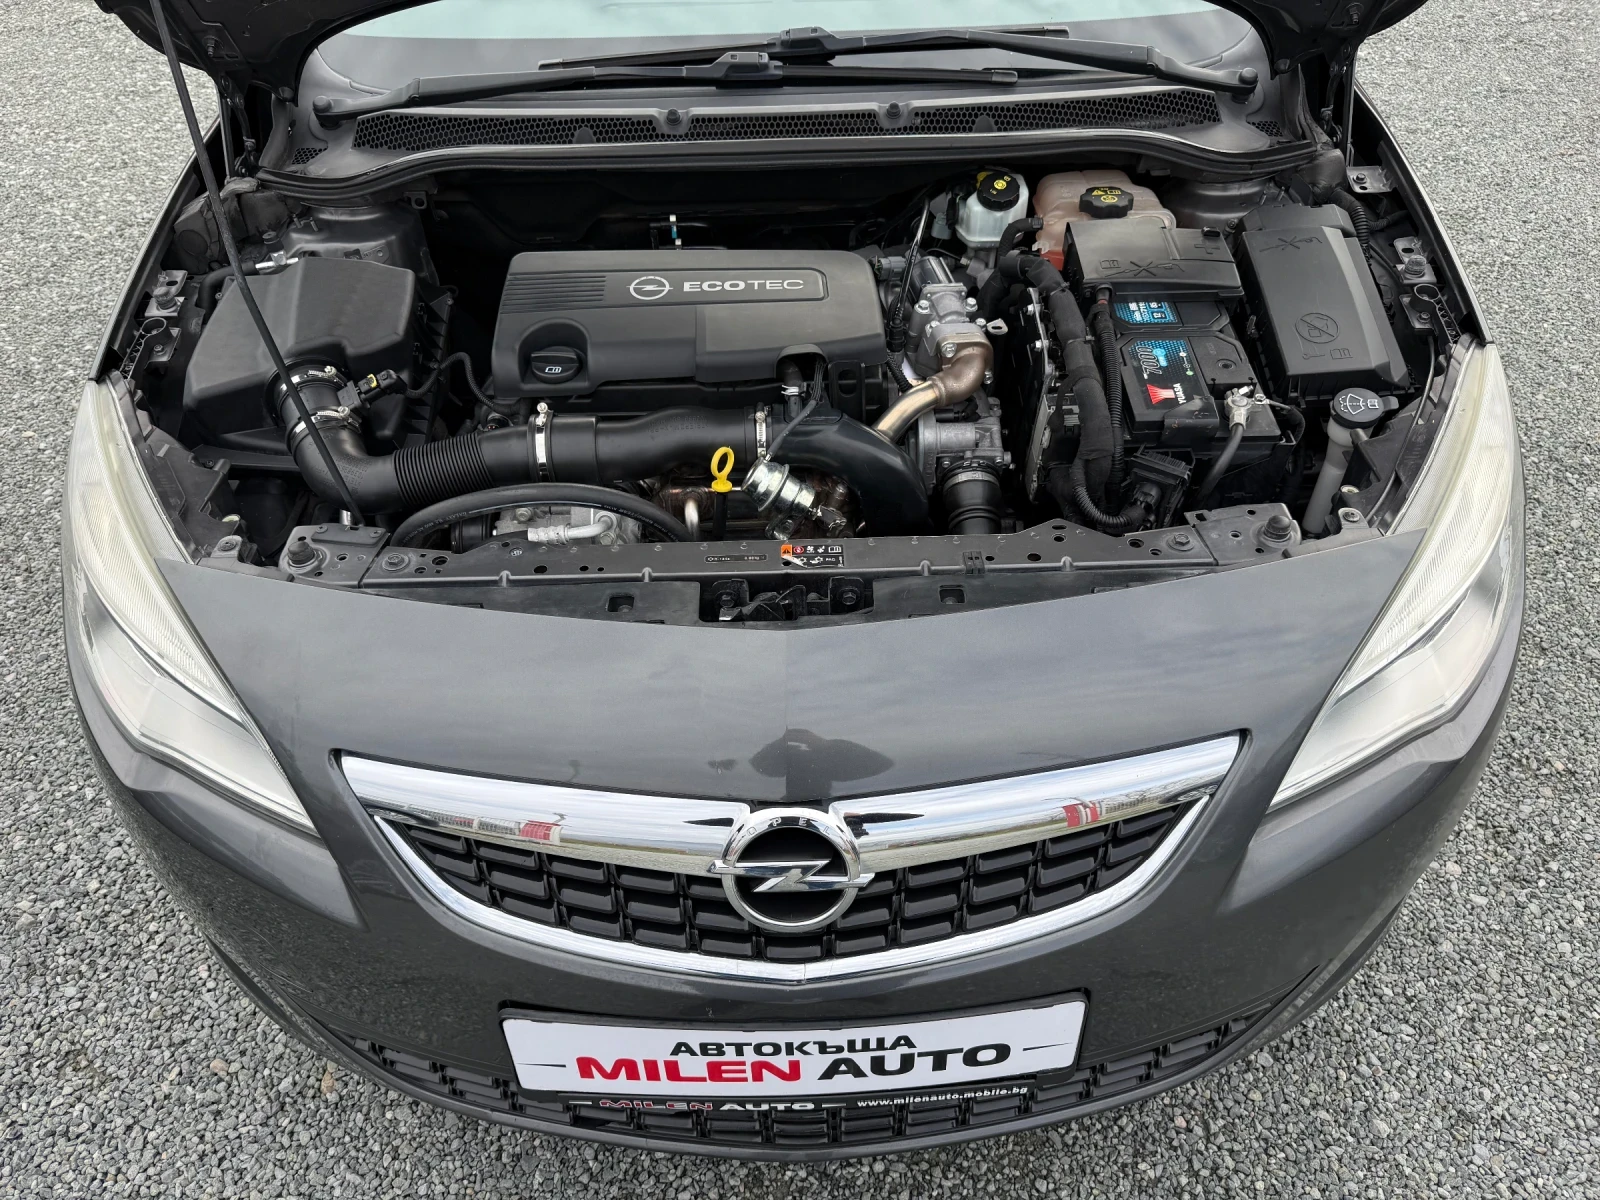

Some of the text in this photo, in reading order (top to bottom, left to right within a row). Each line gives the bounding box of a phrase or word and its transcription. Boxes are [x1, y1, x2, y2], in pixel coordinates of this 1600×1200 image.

[683, 279, 804, 292] ECOTEC
[1135, 345, 1163, 375] 7000
[1173, 383, 1187, 404] YUASA
[746, 816, 831, 837] OPEL
[575, 1043, 1011, 1083] MILEN AUTO
[599, 1086, 1028, 1111] MILEN AUTO www.milenauto.mobile.bg
